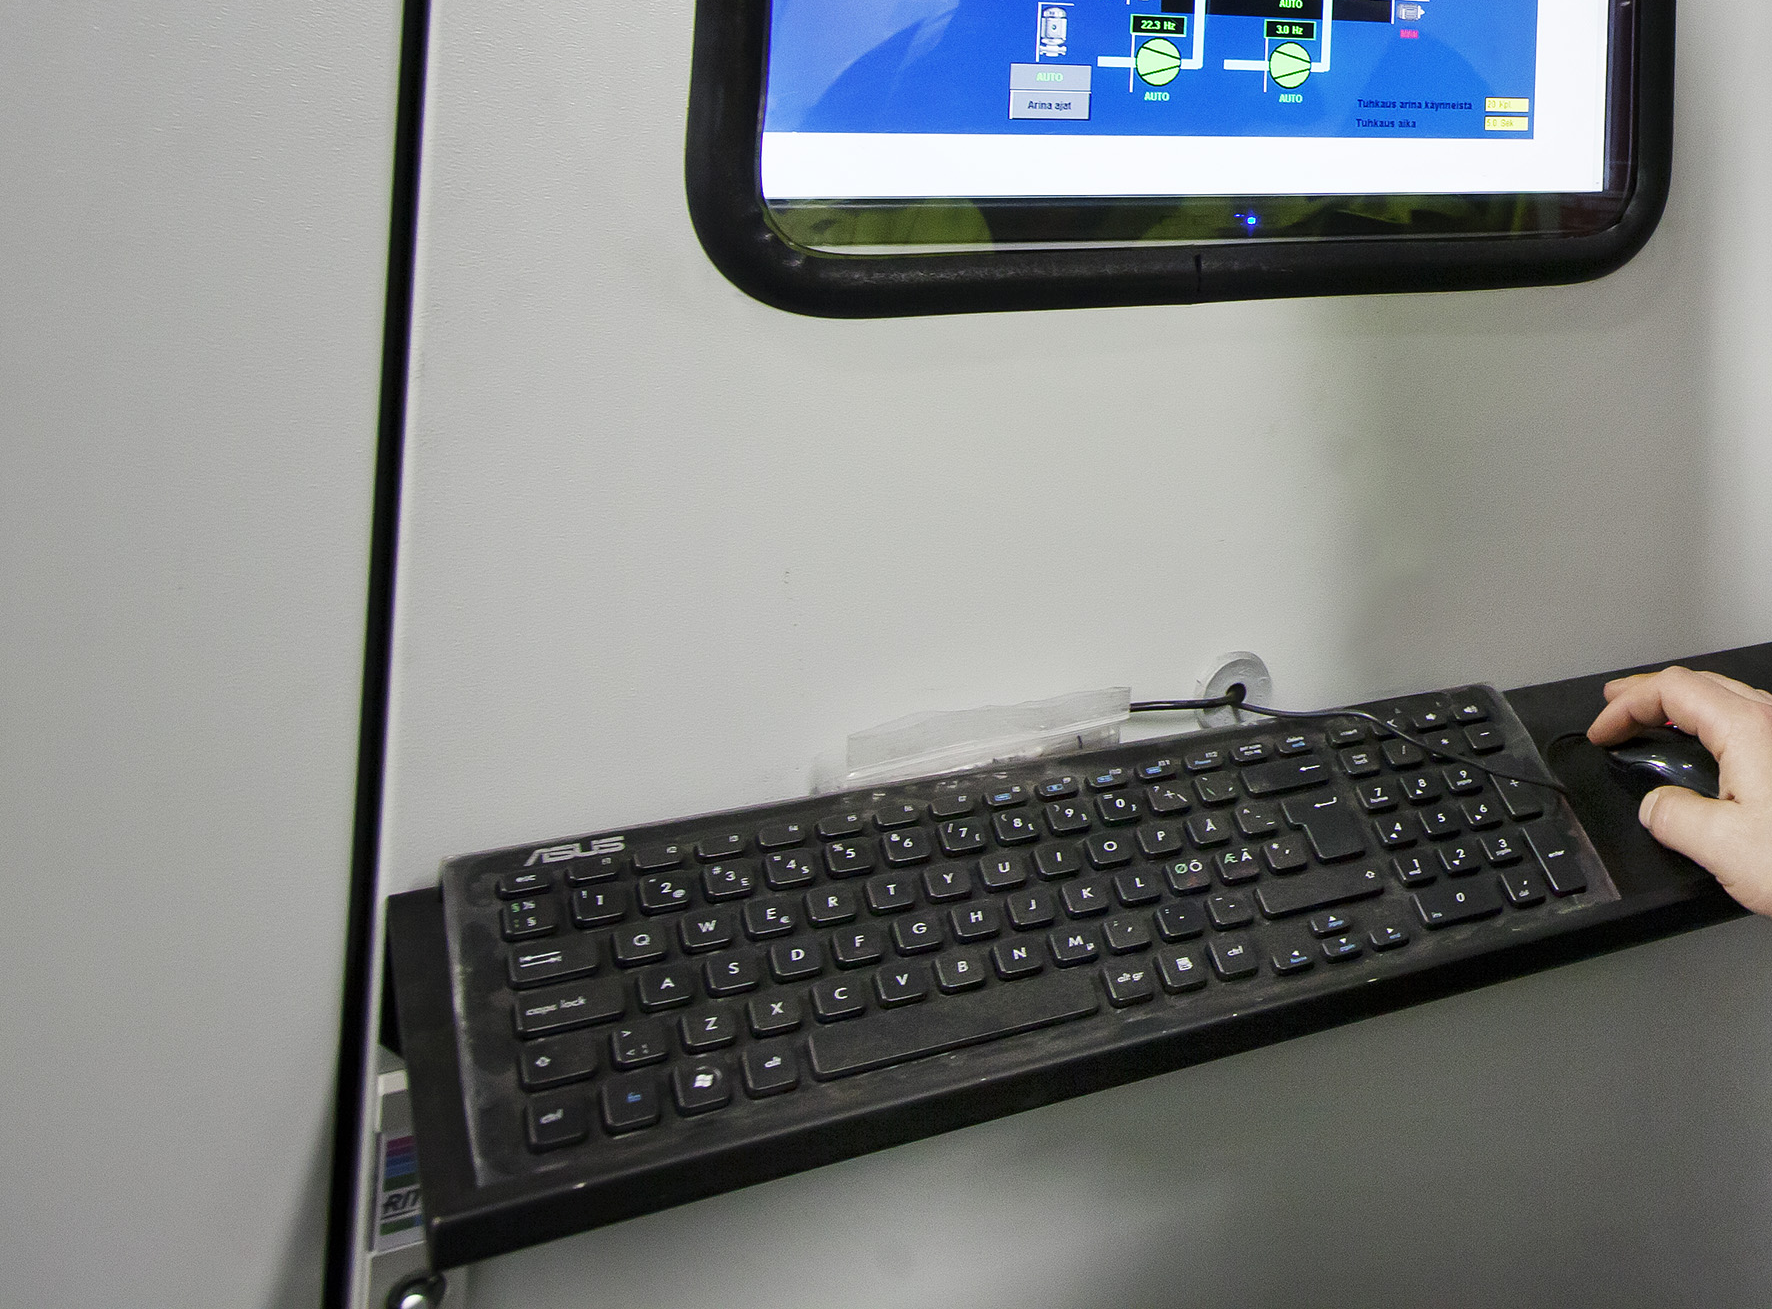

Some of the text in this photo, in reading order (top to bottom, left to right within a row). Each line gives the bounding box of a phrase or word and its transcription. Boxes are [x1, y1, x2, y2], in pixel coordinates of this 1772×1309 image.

[1279, 0, 1303, 9] AUTO
[1141, 20, 1176, 31] 22.3 Hz
[1276, 25, 1303, 35] 3.0 Hz
[1036, 73, 1063, 82] AUTO
[1144, 92, 1169, 101] AUTO
[1279, 94, 1303, 103] AUTO
[1028, 101, 1071, 112] Arina ajat
[1357, 99, 1396, 108] Tuhkaus
[1400, 101, 1422, 109] arina
[1356, 119, 1416, 128] Tuhkaus aika
[1374, 770, 1467, 796] 7 8 9
[1394, 823, 1401, 831] 4
[1438, 813, 1445, 822] 5
[523, 835, 626, 867] ASUS
[661, 883, 672, 893] 2
[726, 871, 735, 881] 3
[786, 860, 796, 868] 4
[846, 849, 855, 858] 5
[903, 838, 912, 847] 6
[959, 828, 967, 837] 7
[1013, 818, 1022, 827] 8
[1065, 809, 1073, 817] 9
[1456, 849, 1465, 858] 2
[1499, 839, 1507, 848] 3
[634, 934, 650, 945] Q
[698, 920, 716, 932] W
[767, 908, 776, 920] E
[828, 897, 838, 907] R
[887, 884, 896, 895] T
[943, 873, 953, 883] Y
[998, 862, 1010, 872] U
[1157, 831, 1165, 841] P
[661, 978, 674, 989] A
[728, 963, 739, 974] S
[791, 949, 804, 961] D
[855, 935, 864, 947] F
[913, 923, 926, 933] G
[970, 911, 982, 922] H
[1029, 900, 1036, 910] J
[1082, 888, 1093, 898] K
[1135, 878, 1144, 887] L
[705, 936, 1083, 1030] Z X C V B N M
